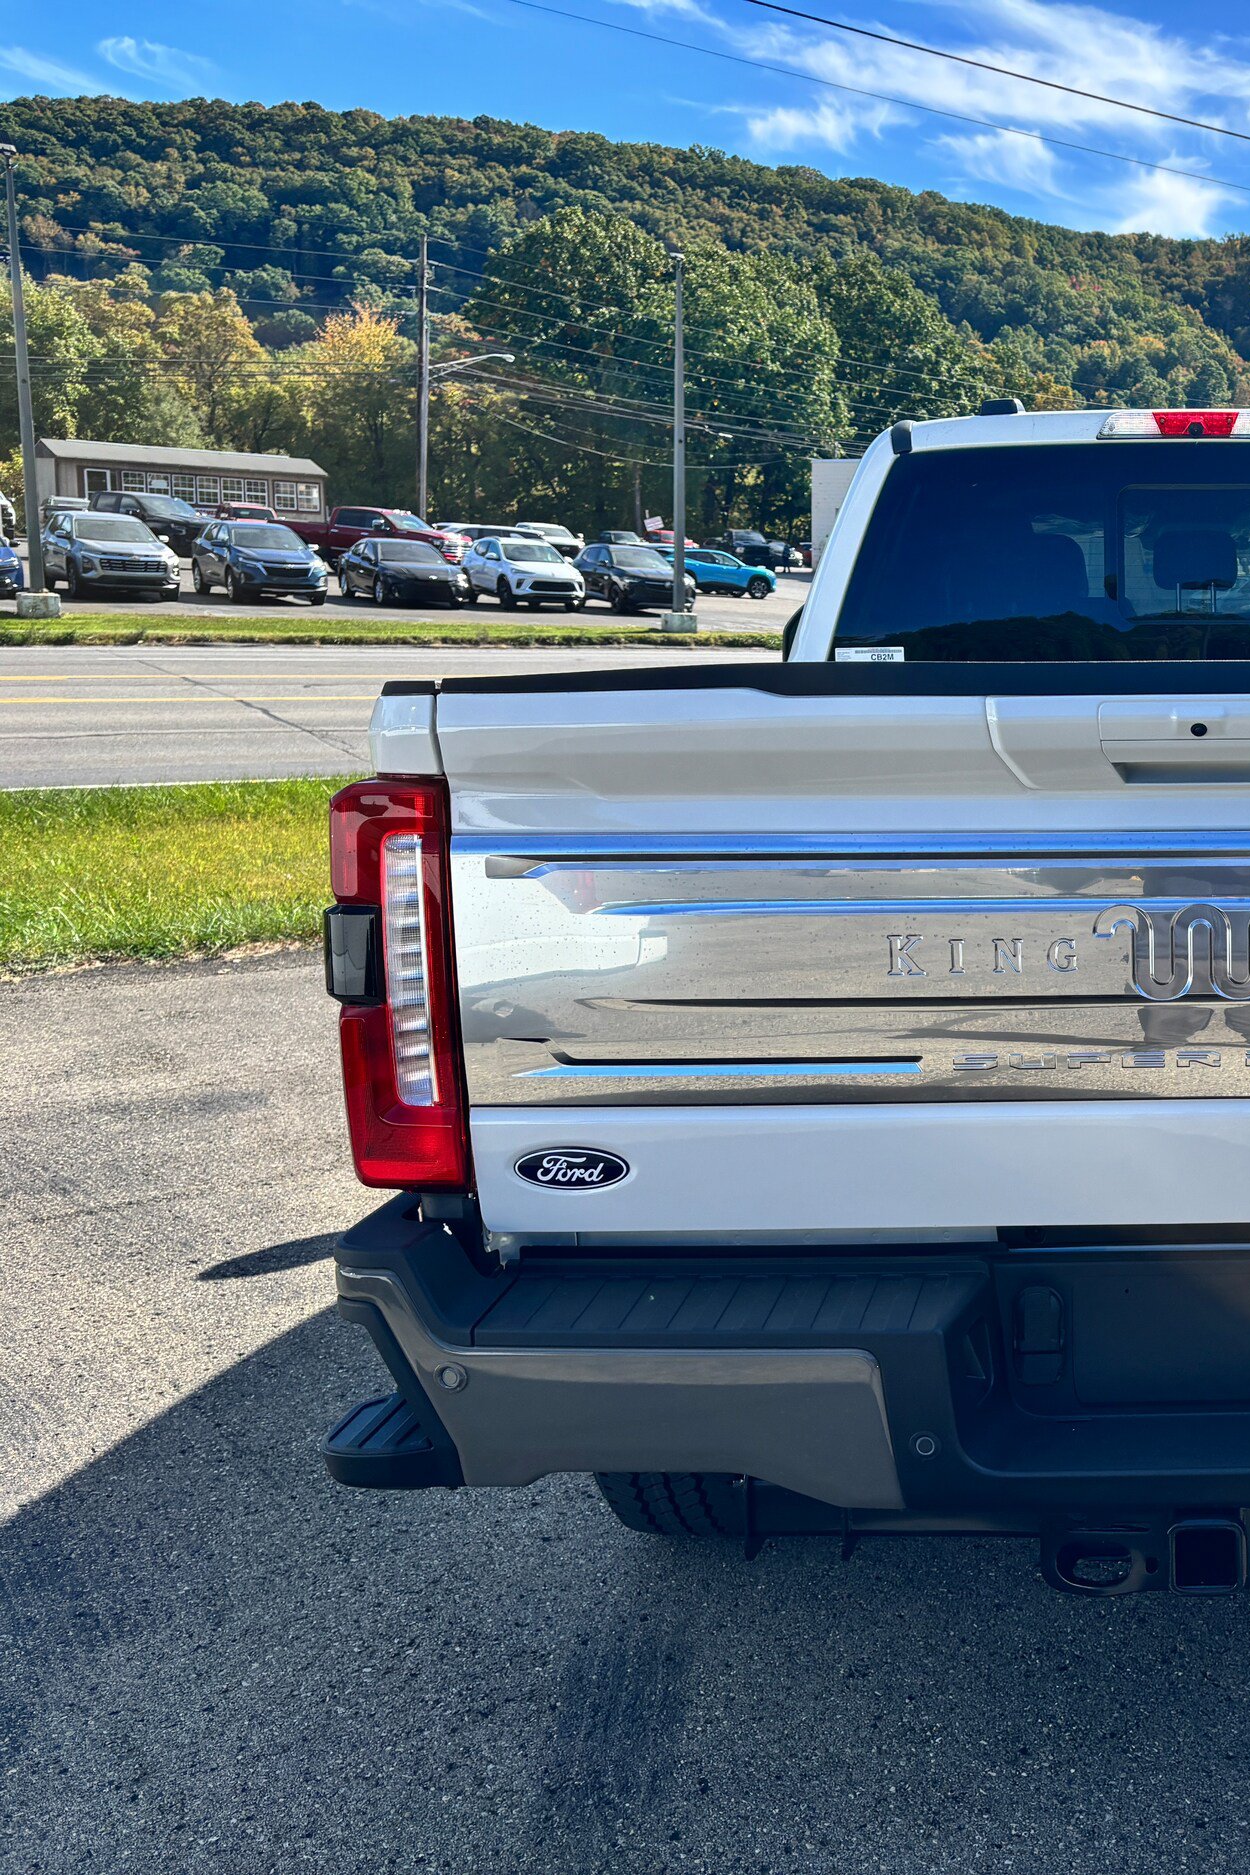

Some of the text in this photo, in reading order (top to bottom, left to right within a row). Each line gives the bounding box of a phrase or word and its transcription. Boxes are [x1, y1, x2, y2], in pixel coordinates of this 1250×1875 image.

[870, 653, 894, 661] CB2M
[886, 932, 1079, 977] KING
[951, 1049, 1222, 1071] SUPER
[537, 1155, 604, 1182] Ford
